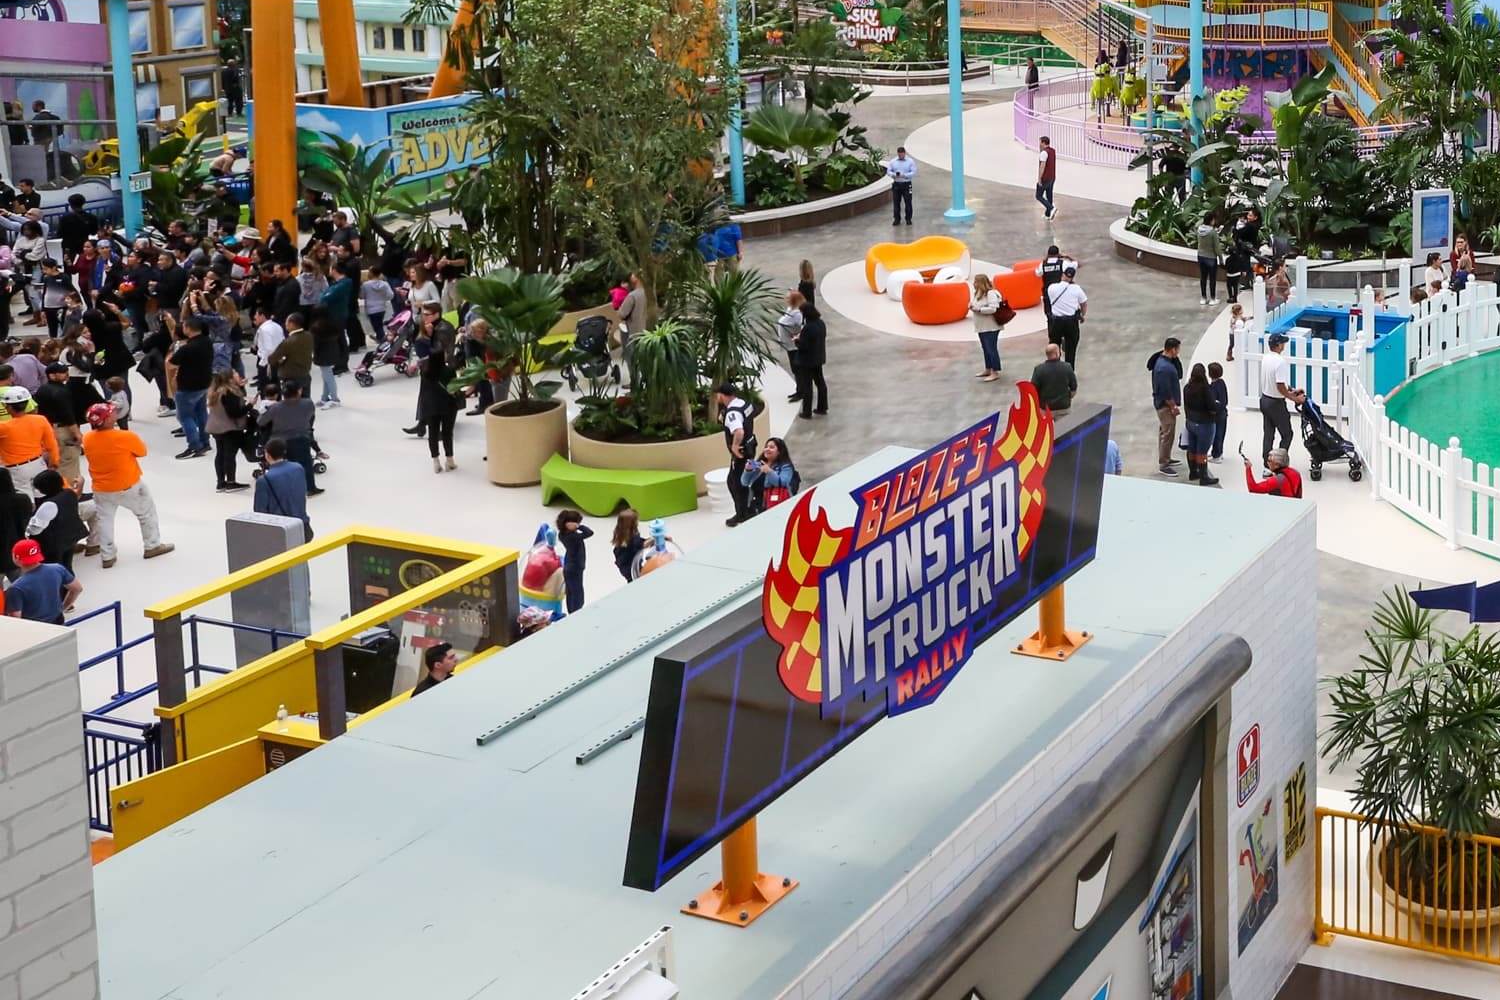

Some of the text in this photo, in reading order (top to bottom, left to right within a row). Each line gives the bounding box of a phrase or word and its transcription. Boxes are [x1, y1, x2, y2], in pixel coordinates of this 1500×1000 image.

[847, 8, 879, 27] SKY
[402, 116, 456, 131] Welcome
[855, 424, 992, 551] BLAZE'S
[825, 465, 1017, 702] MONSTER
[867, 550, 993, 683] TRUCK
[896, 627, 969, 706] RALLY
